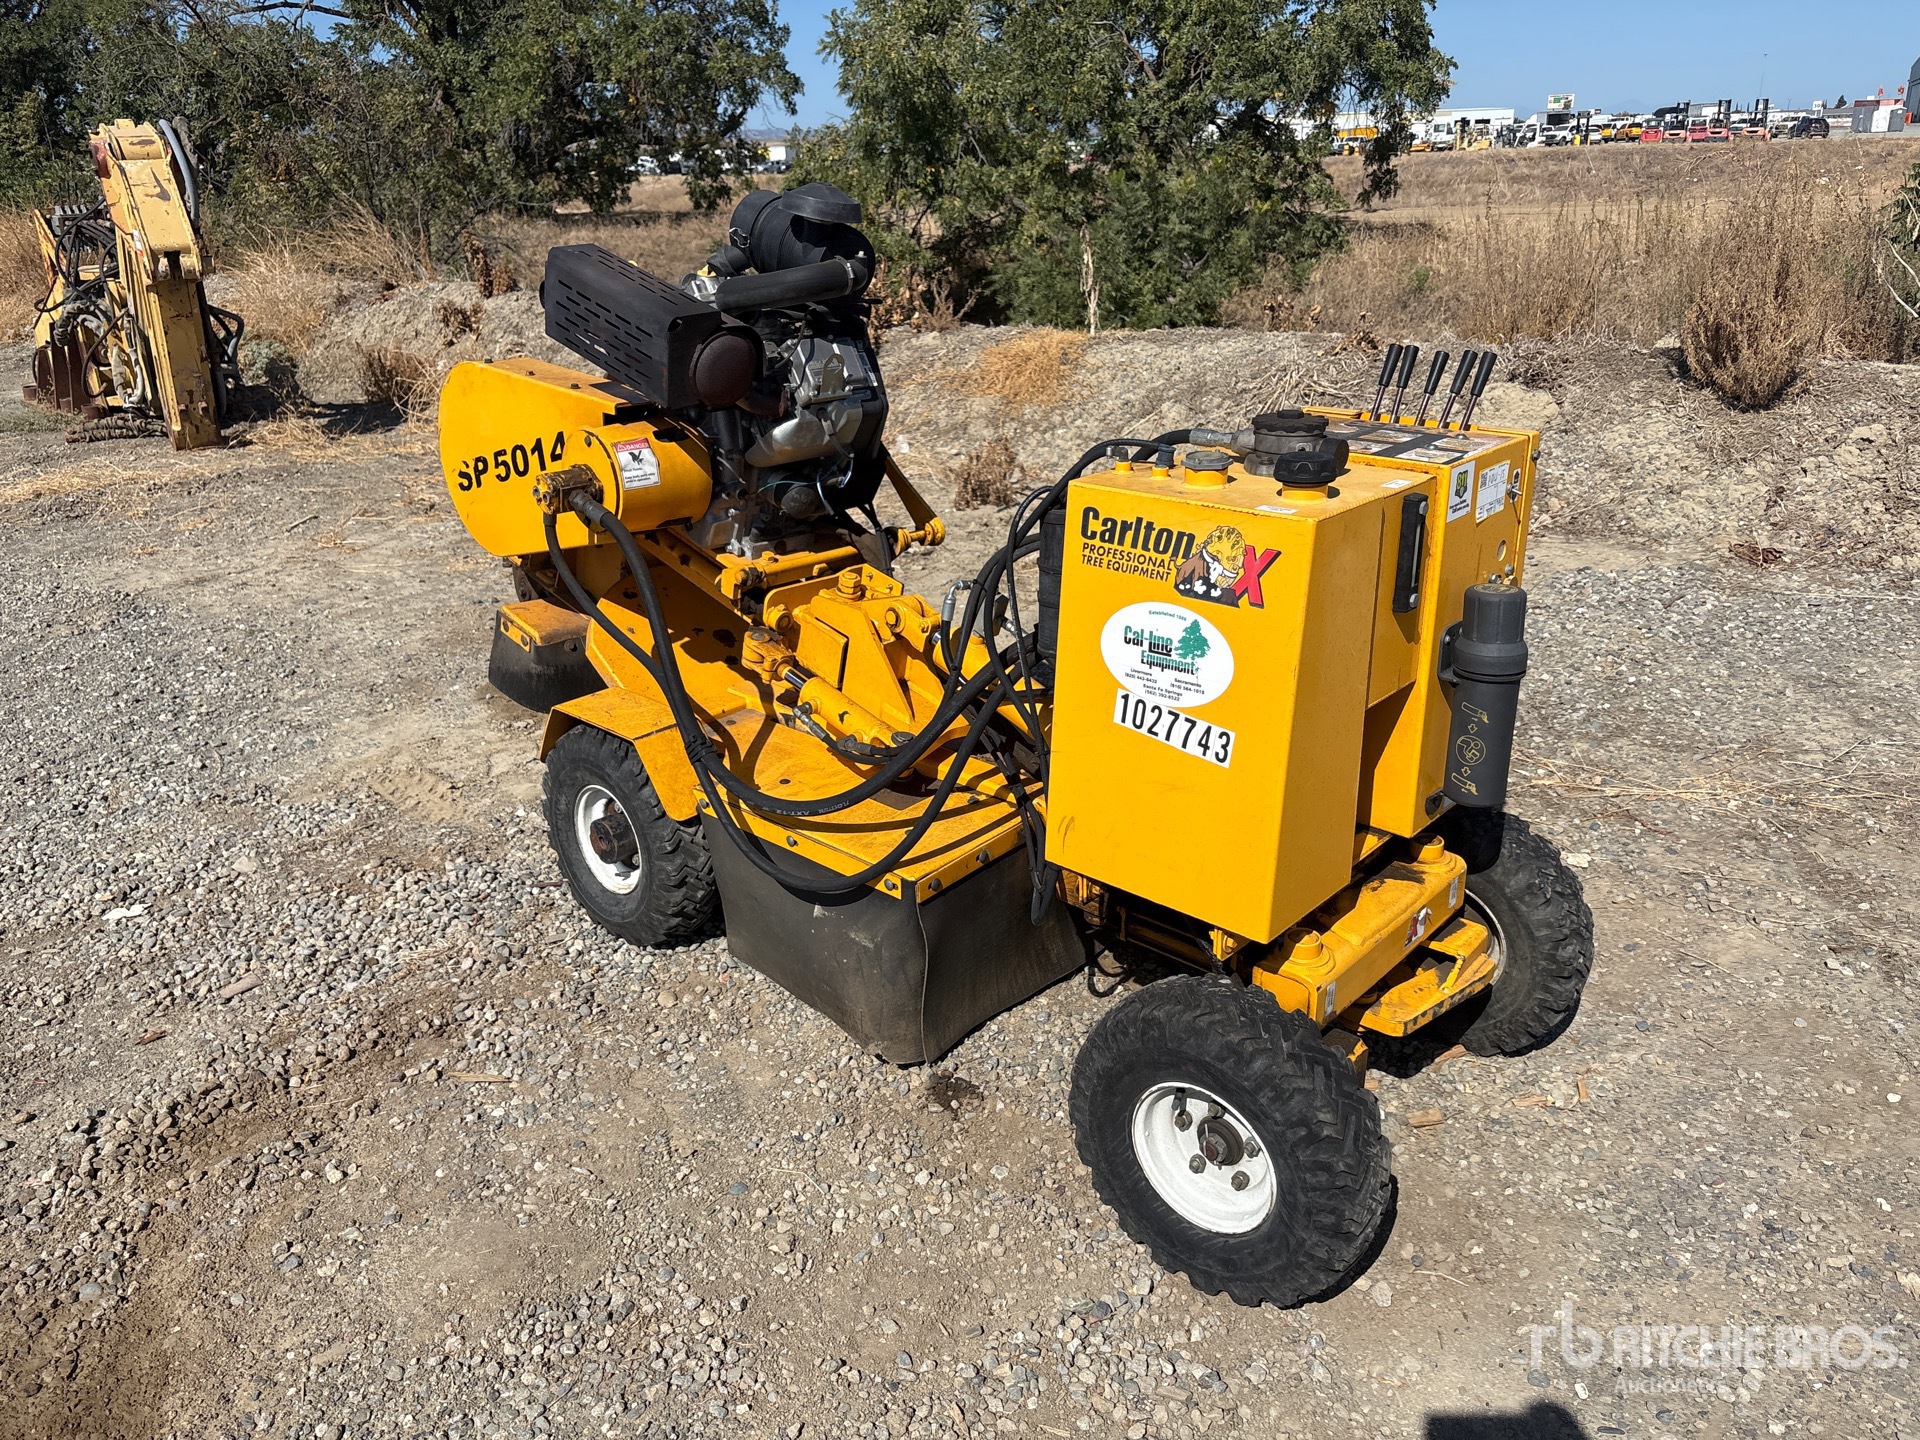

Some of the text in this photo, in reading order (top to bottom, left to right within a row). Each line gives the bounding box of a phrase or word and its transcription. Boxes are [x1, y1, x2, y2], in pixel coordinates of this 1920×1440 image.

[625, 442, 650, 451] DANGER
[1080, 506, 1196, 561] Carlton
[1082, 542, 1173, 571] PROFESSIONAL
[1081, 553, 1172, 582] TREE EQUIPMENT
[1148, 610, 1175, 618] Established
[1130, 667, 1153, 677] Livermore
[1141, 650, 1196, 676] Equipment
[1174, 678, 1202, 688] Sacramento
[1164, 688, 1183, 697] Springs
[1120, 693, 1231, 764] 1027743
